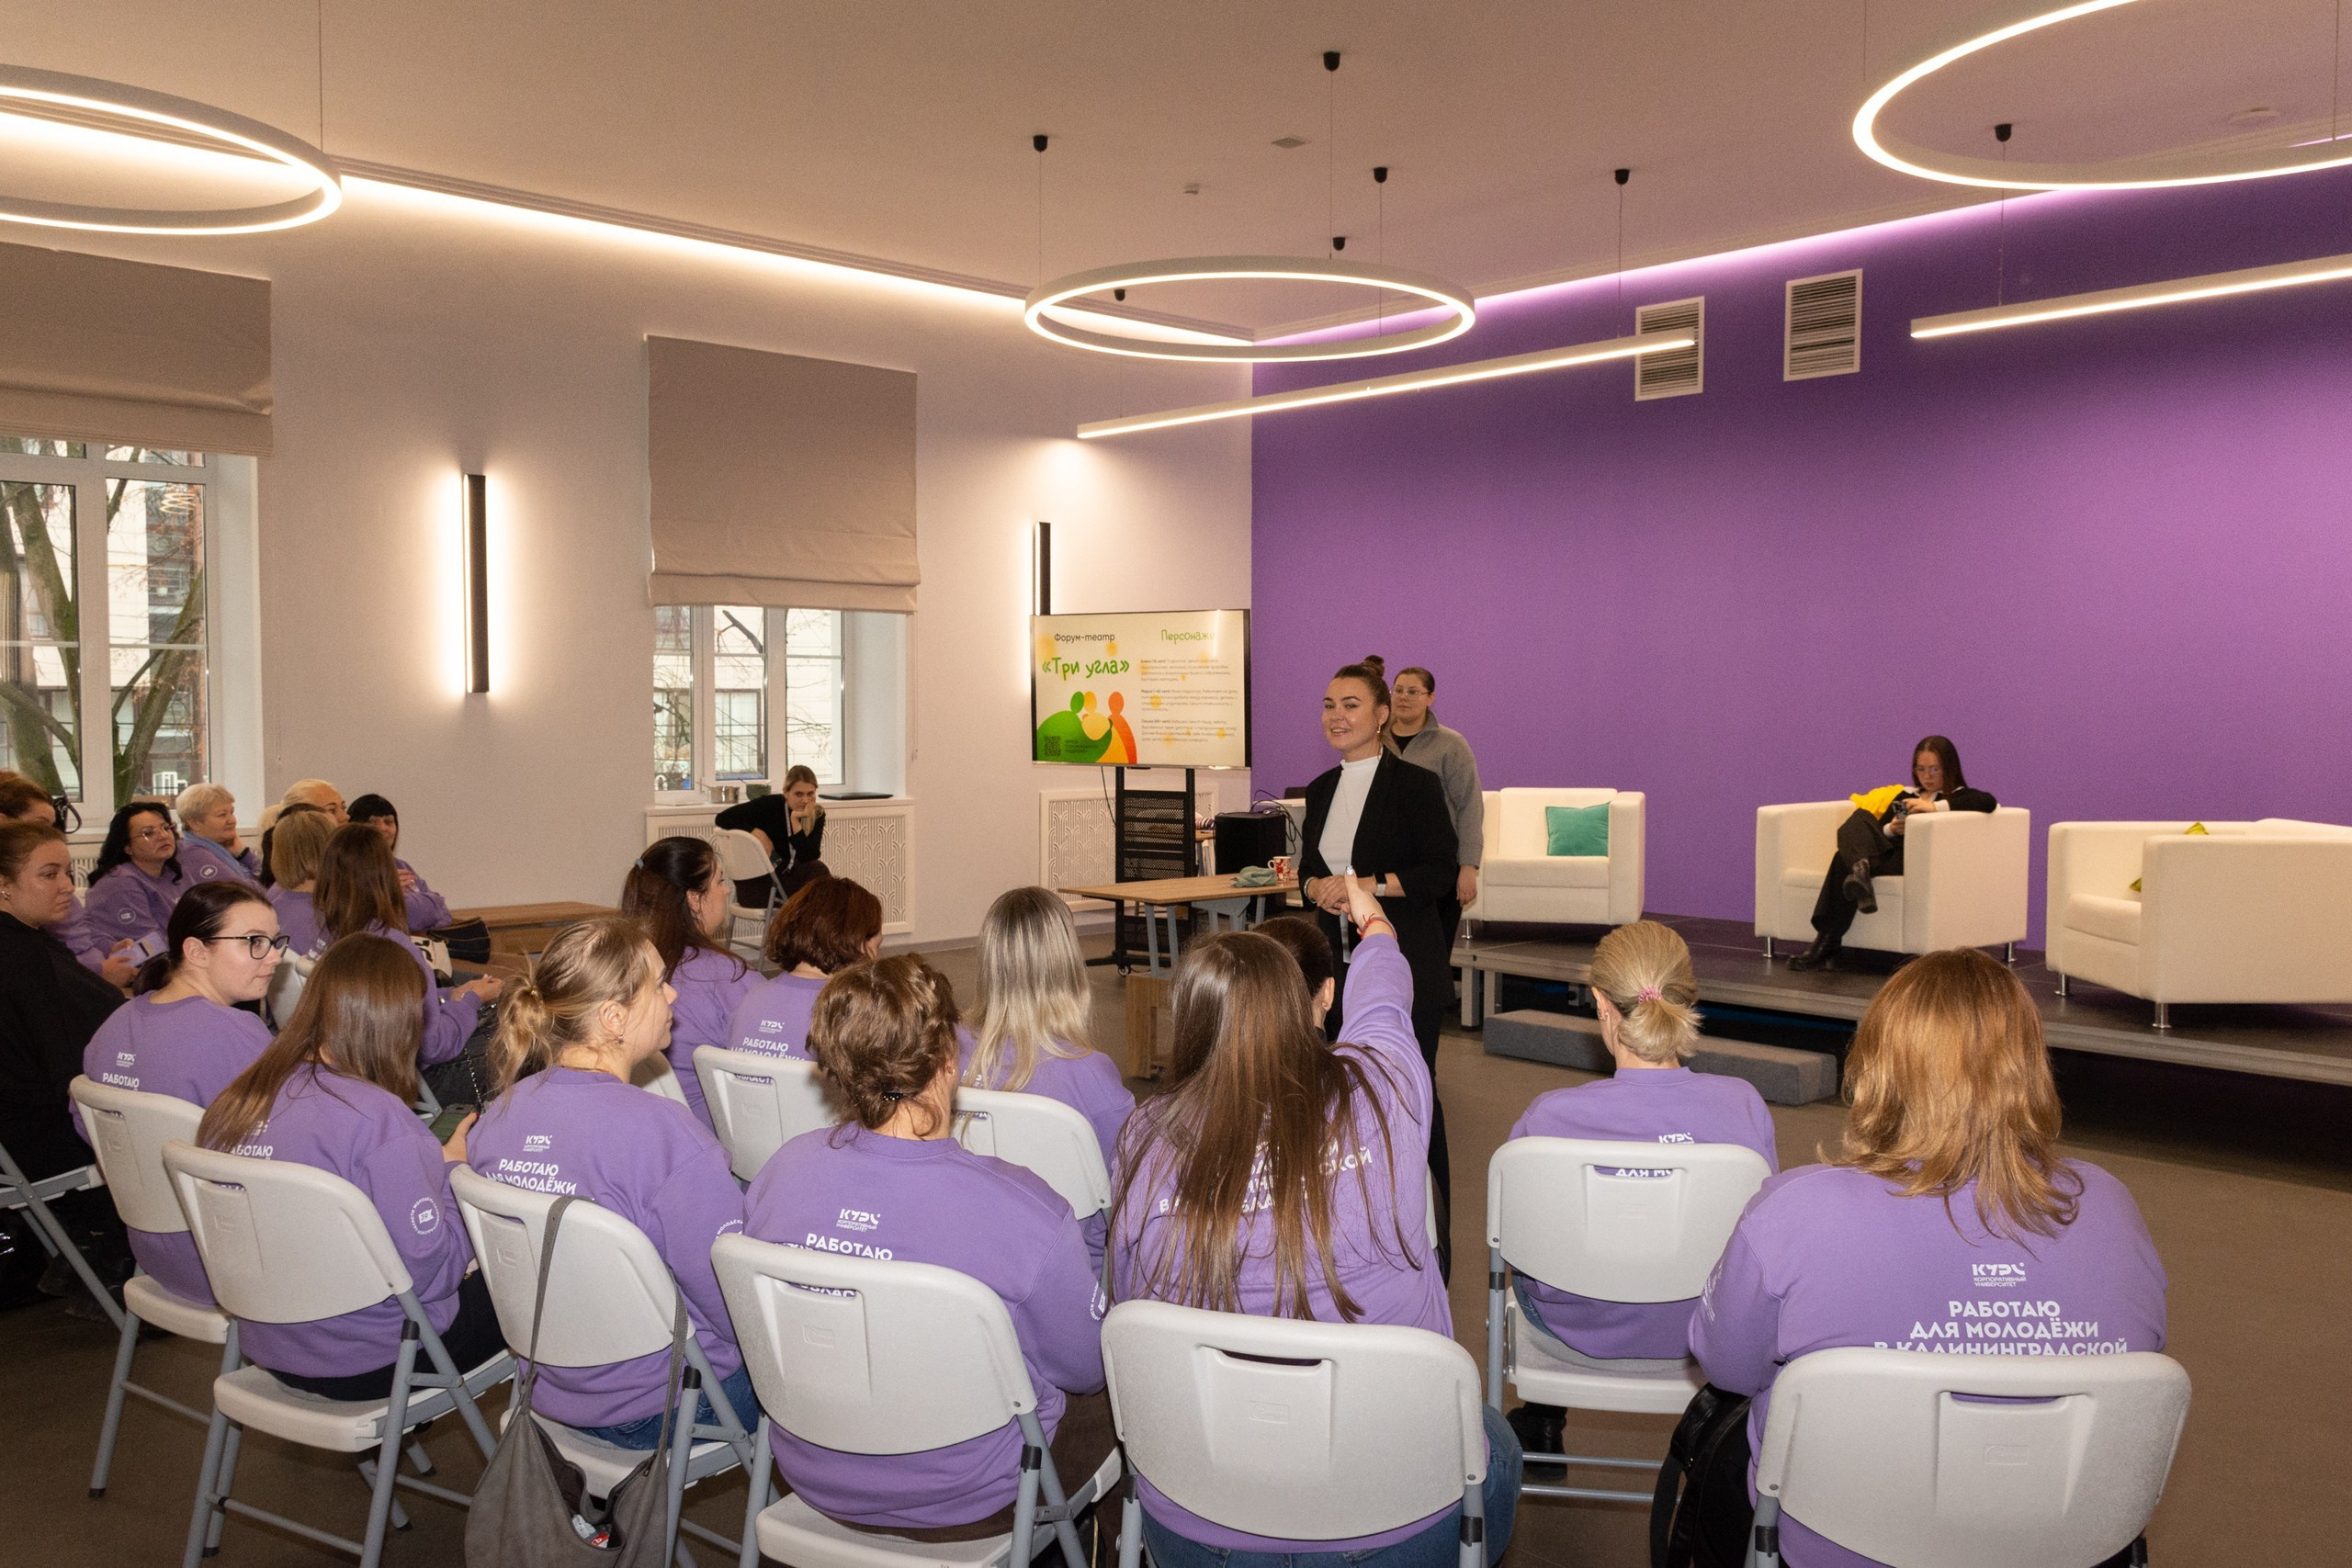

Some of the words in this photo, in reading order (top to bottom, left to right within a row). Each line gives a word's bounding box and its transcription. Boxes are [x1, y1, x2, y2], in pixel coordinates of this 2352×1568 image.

[1054, 633, 1115, 643] Форум-театр
[1042, 657, 1080, 681] «Три
[1086, 659, 1130, 679] угла»
[742, 1038, 788, 1052] РАБОТАЮ
[102, 1073, 140, 1088] РАБОТАЮ
[230, 1145, 274, 1156] АБОТАЮ
[499, 1159, 559, 1176] РАБОТАЮ
[504, 1175, 577, 1195] МОЛОДЁЖИ
[806, 1233, 893, 1260] РАБОТАЮ
[1949, 1301, 2061, 1318] РАБОТАЮ
[1910, 1321, 1960, 1339] ДЛЯ
[1965, 1317, 2098, 1339] МОЛОДЁЖИ
